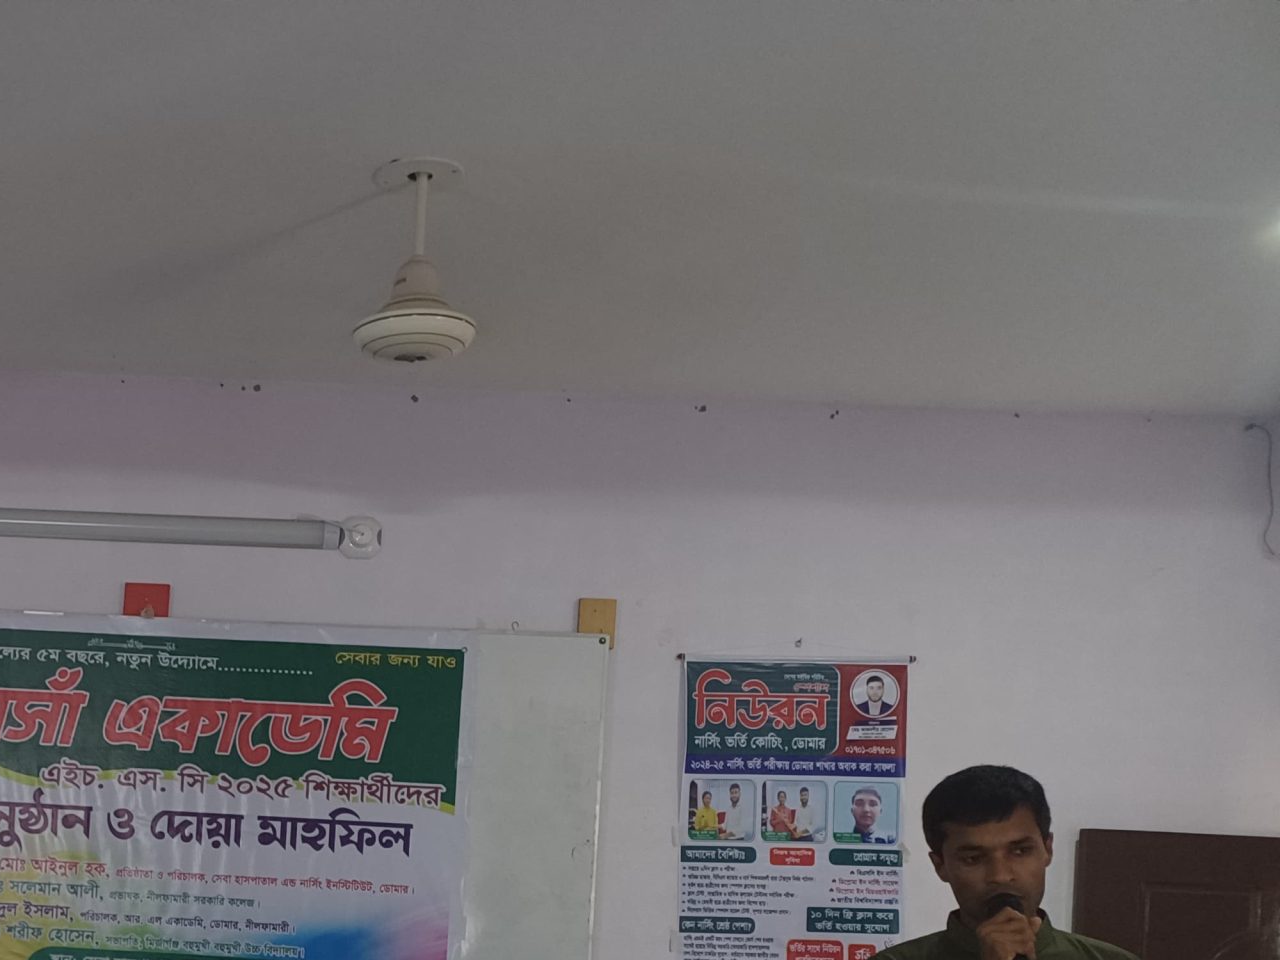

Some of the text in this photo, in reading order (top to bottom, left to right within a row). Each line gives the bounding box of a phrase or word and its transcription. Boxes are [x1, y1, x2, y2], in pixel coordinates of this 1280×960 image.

[37, 649, 61, 663] ৫ম
[65, 649, 109, 668] বছরে,
[117, 652, 151, 670] নতুন
[335, 651, 457, 669] সেবার জন্য যাও
[693, 668, 830, 730] নিউরন
[103, 678, 398, 766] একাডেমি
[694, 732, 721, 749] নার্সিং
[725, 731, 749, 747] ভর্তি
[792, 737, 826, 750] ডোমার
[42, 758, 444, 808] এইচ. এস. সি ২০২৫ শিক্ষার্থীদের
[107, 807, 136, 840] ও
[150, 809, 244, 849] দোয়া
[257, 807, 413, 857] মাহফিল
[0, 857, 26, 872] মোঃ
[31, 857, 78, 878] আইনুল
[84, 863, 110, 878] হক,
[157, 870, 164, 880] ও
[211, 874, 232, 885] সেবা
[235, 875, 278, 888] হাসপাতাল
[281, 877, 297, 888] এন্ড
[300, 876, 322, 890] নার্সিং
[10, 879, 61, 895] সলেমান
[66, 877, 103, 900] আলী,
[23, 901, 73, 921] ইসলাম,
[147, 915, 162, 926] এল
[165, 914, 206, 929] একাডেমি,
[210, 919, 241, 931] ডোমার,
[7, 921, 43, 941] শরীফ
[48, 927, 99, 946] হোসেন,
